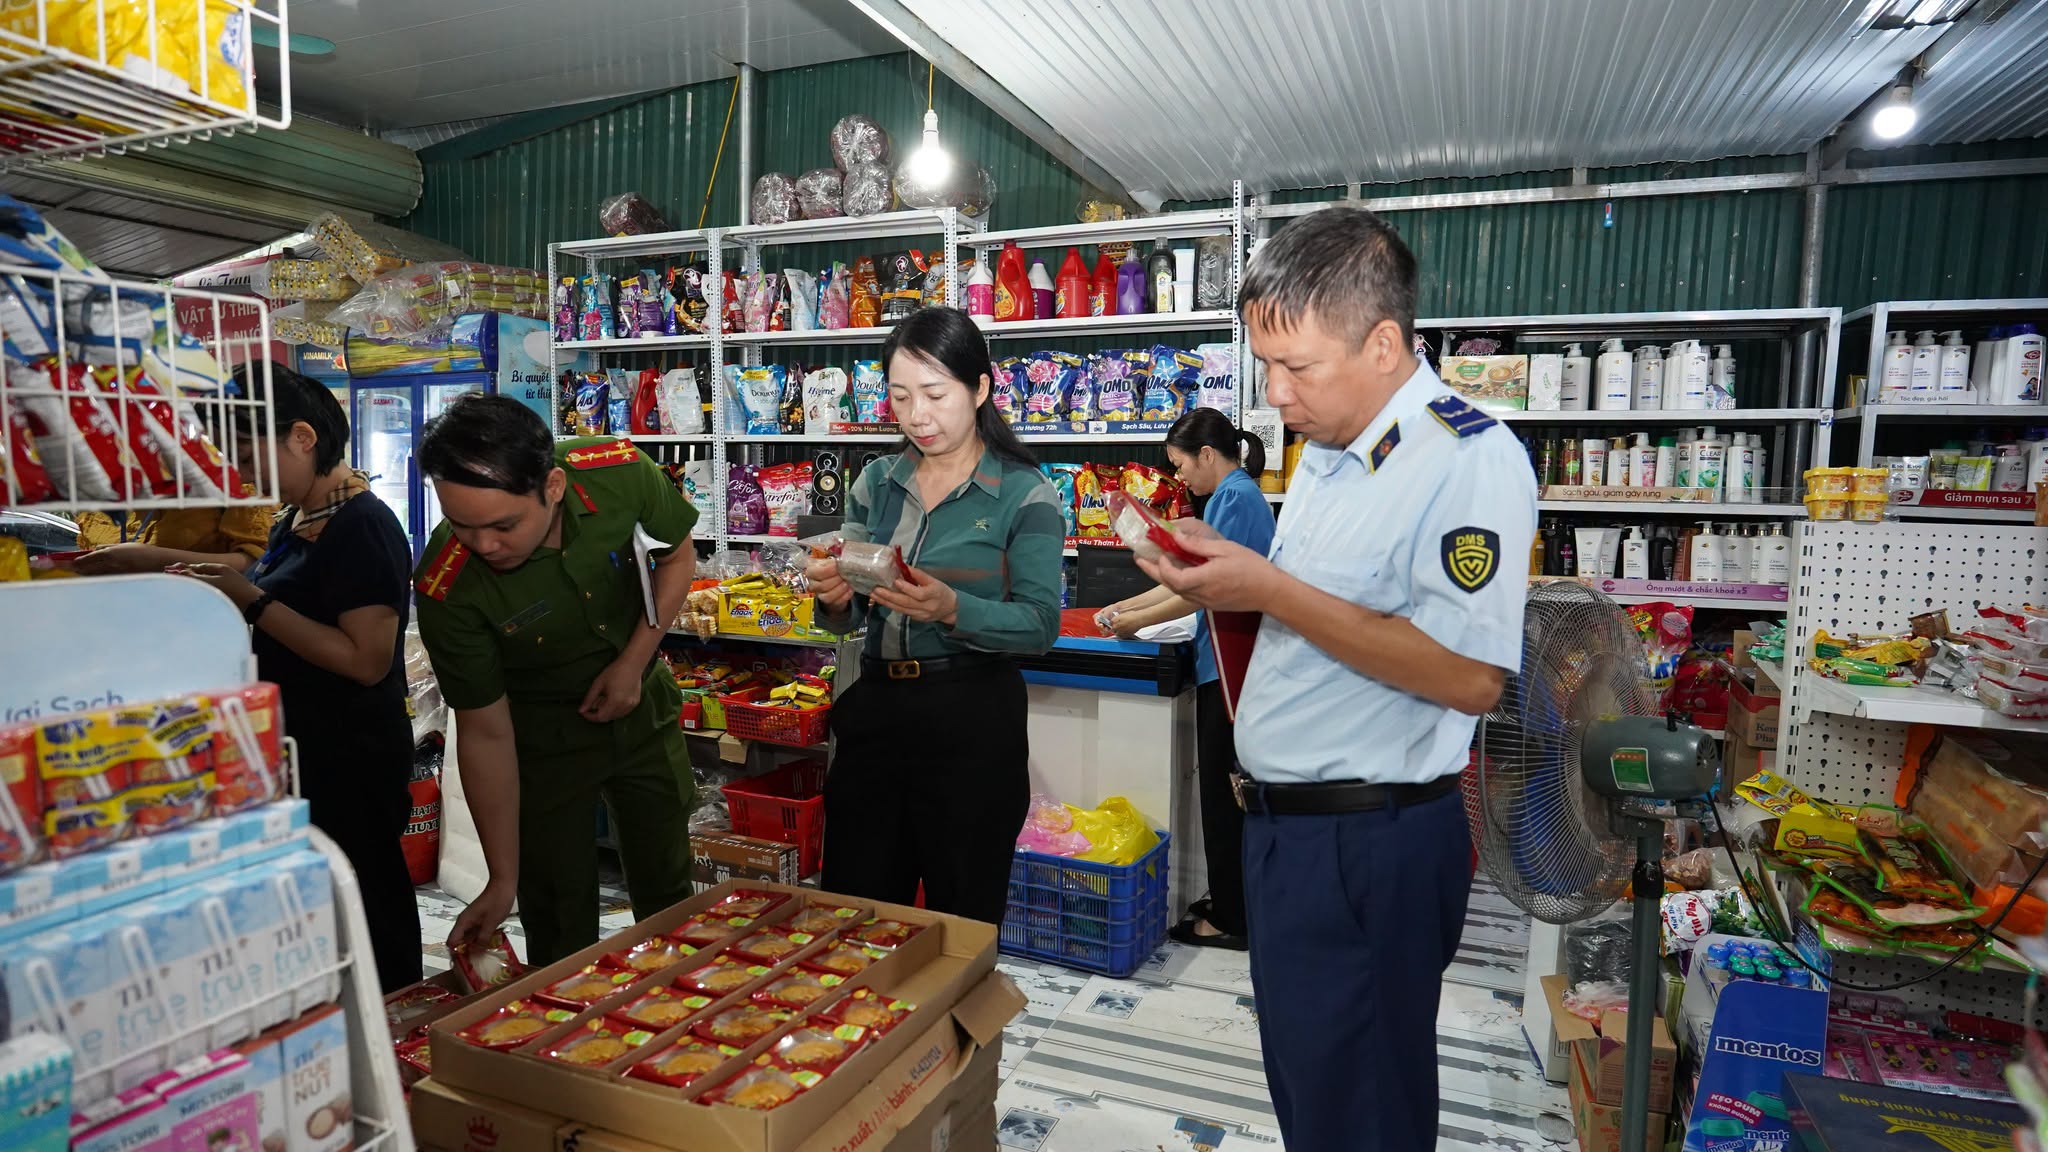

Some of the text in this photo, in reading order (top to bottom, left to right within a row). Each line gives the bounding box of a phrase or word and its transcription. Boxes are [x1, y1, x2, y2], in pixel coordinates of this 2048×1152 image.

[303, 352, 332, 360] VINAMILK
[1103, 379, 1131, 393] OMO
[1147, 375, 1172, 390] OMO
[1203, 375, 1233, 390] OMO
[994, 384, 1012, 396] MO
[764, 491, 798, 505] arefor
[1944, 492, 1972, 503] Giảm
[1975, 496, 1999, 505] mụn
[2001, 495, 2021, 504] sau
[1455, 533, 1486, 547] DMS
[1715, 1036, 1821, 1067] mentos
[1734, 1100, 1762, 1118] GUM
[1743, 1129, 1791, 1141] mento
